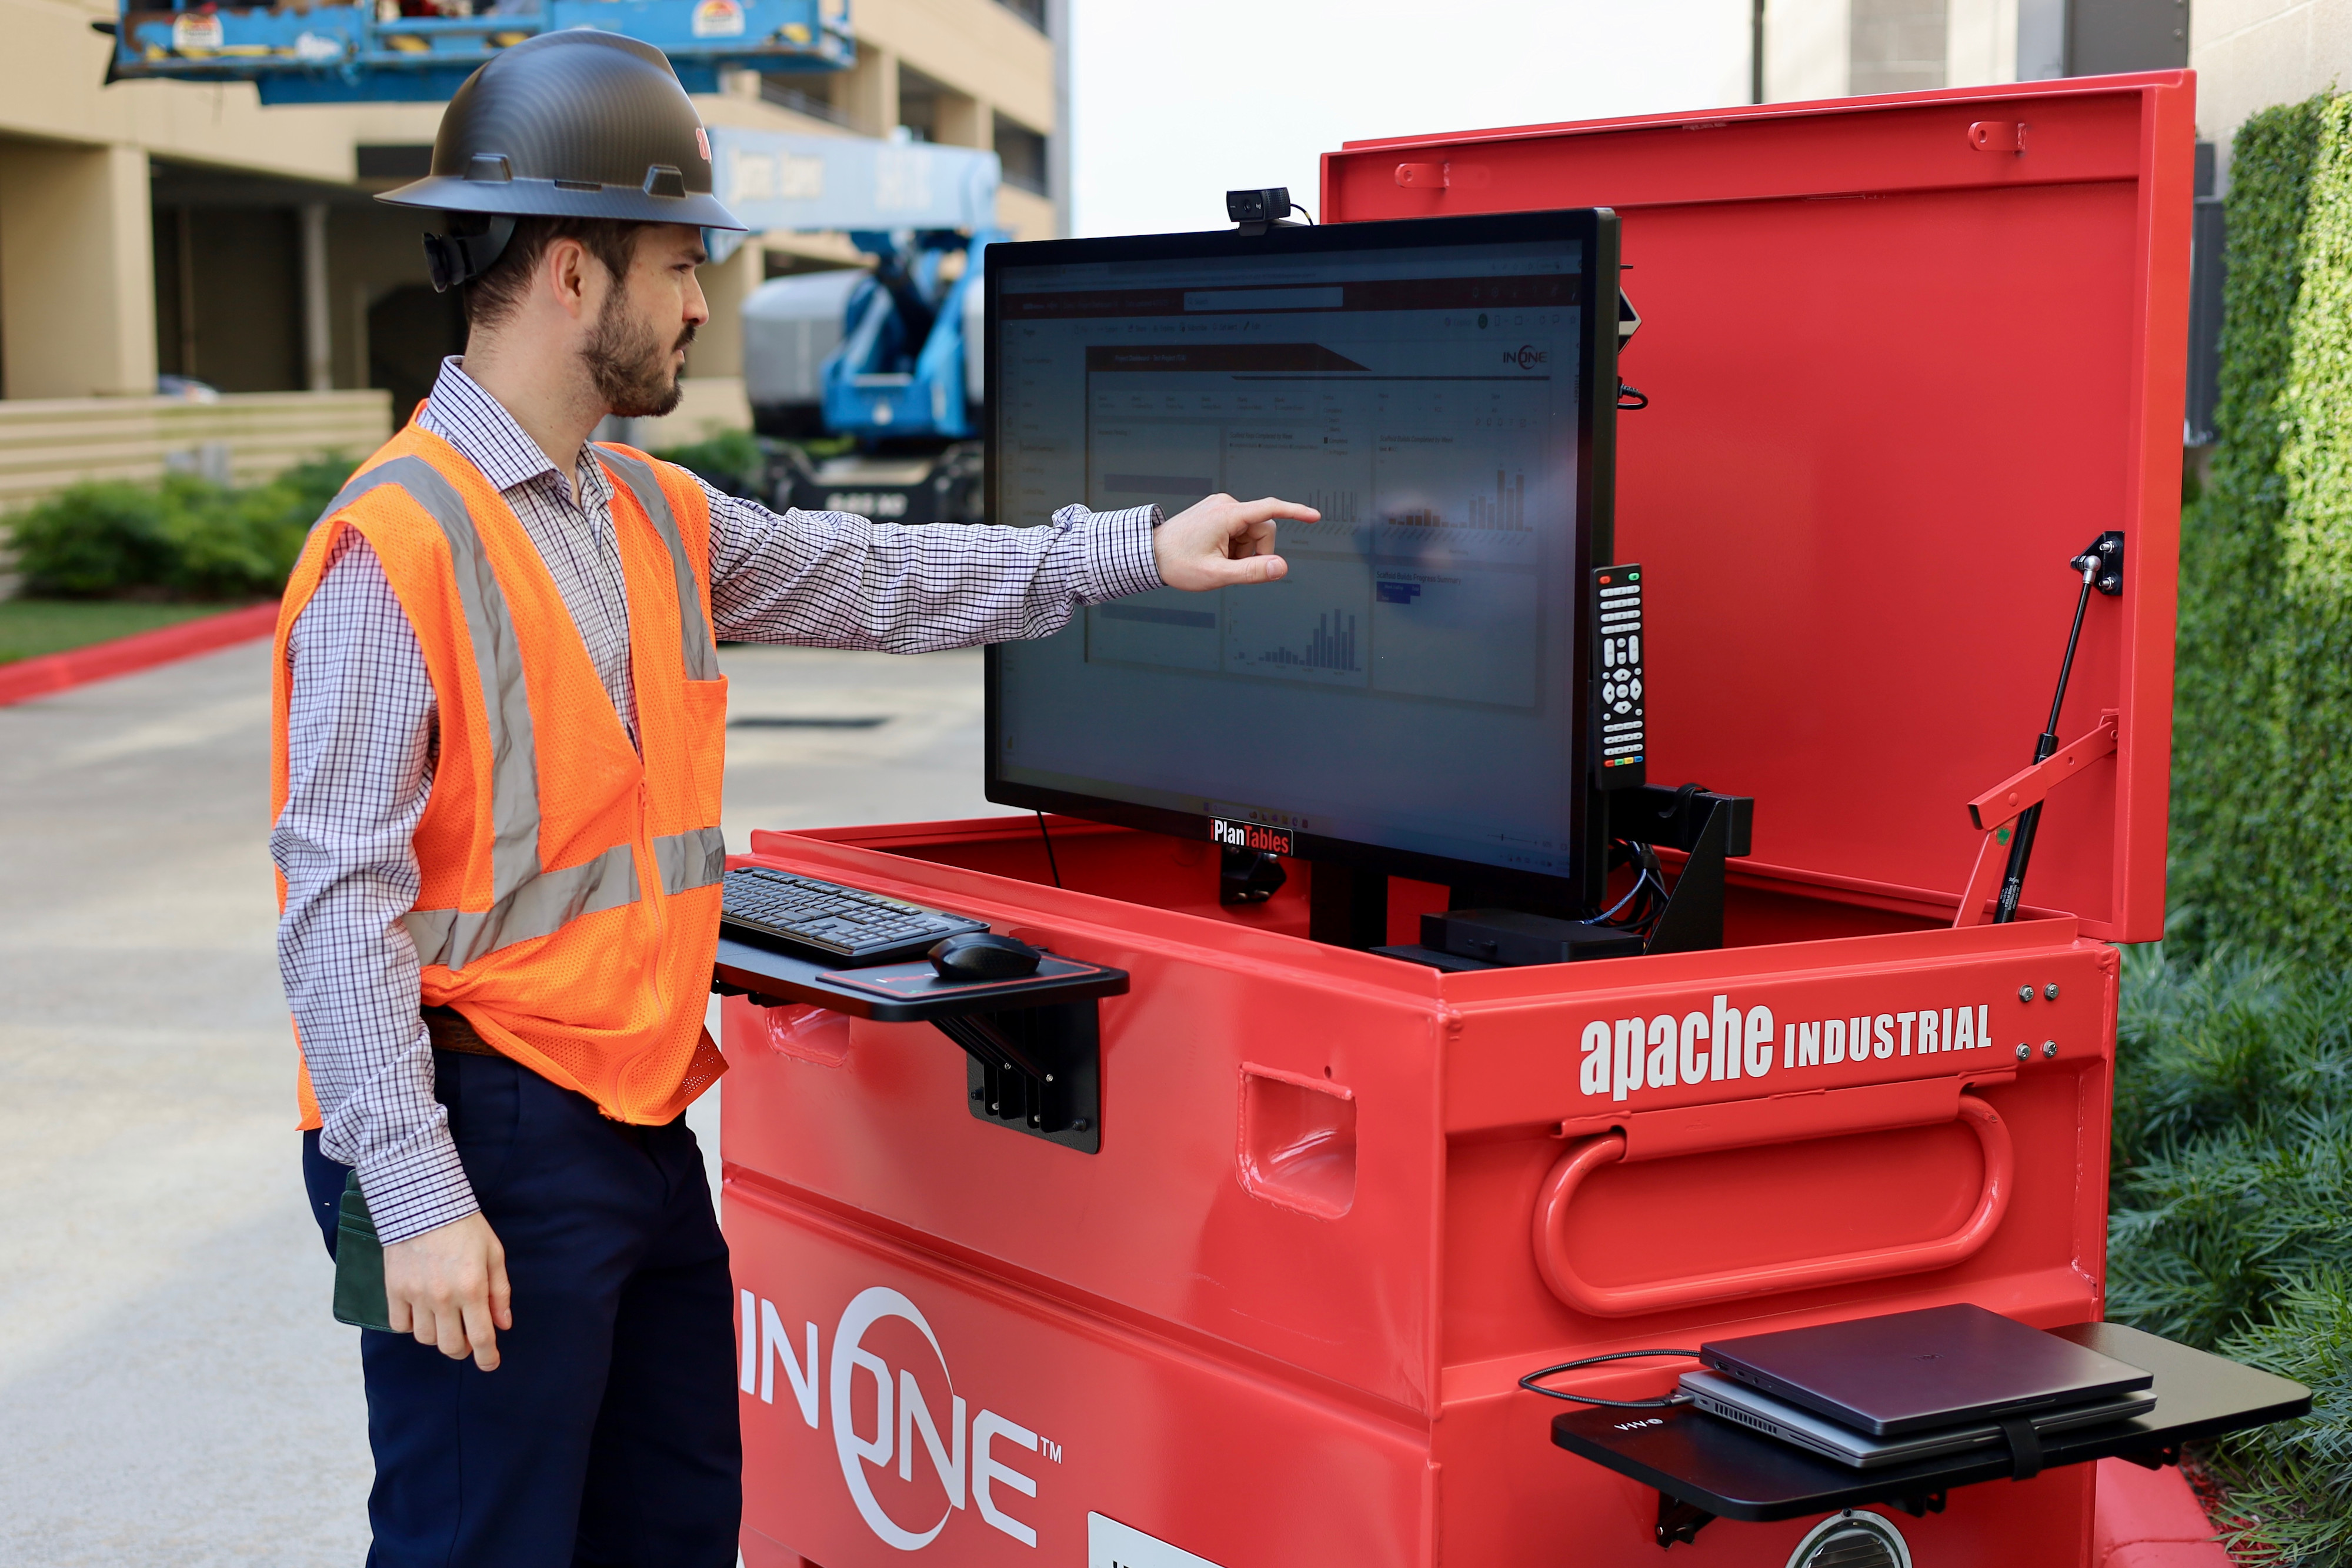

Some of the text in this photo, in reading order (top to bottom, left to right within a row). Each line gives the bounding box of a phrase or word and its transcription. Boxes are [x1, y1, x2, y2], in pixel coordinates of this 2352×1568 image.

[1377, 571, 1462, 586] Scaffold Builds Progress Summary
[1210, 818, 1289, 854] iPlanTables
[1579, 994, 1993, 1102] apache INDUSTRIAL
